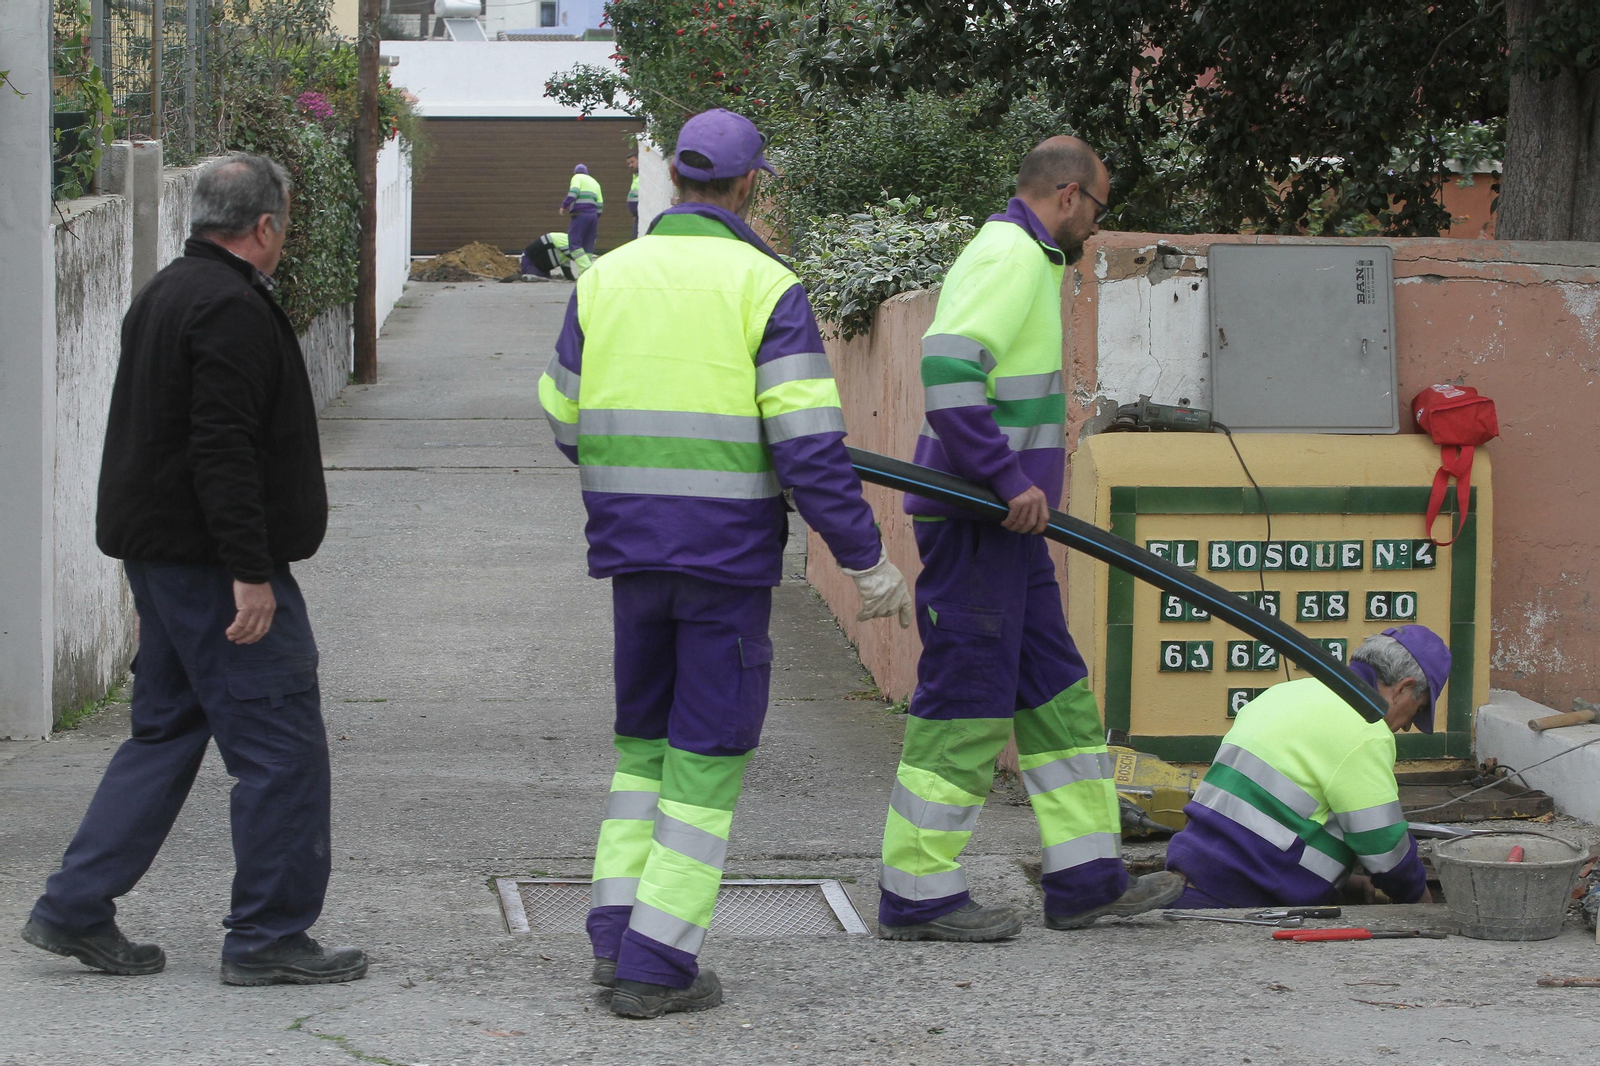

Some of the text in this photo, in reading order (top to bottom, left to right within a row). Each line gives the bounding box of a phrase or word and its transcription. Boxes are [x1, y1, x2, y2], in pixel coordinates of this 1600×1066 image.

[1356, 267, 1365, 304] BAN
[1212, 543, 1360, 567] BOSQUE
[1301, 594, 1345, 617] 58
[1370, 594, 1414, 617] 60
[1231, 644, 1276, 667] 62
[1117, 754, 1134, 782] BOSCH
